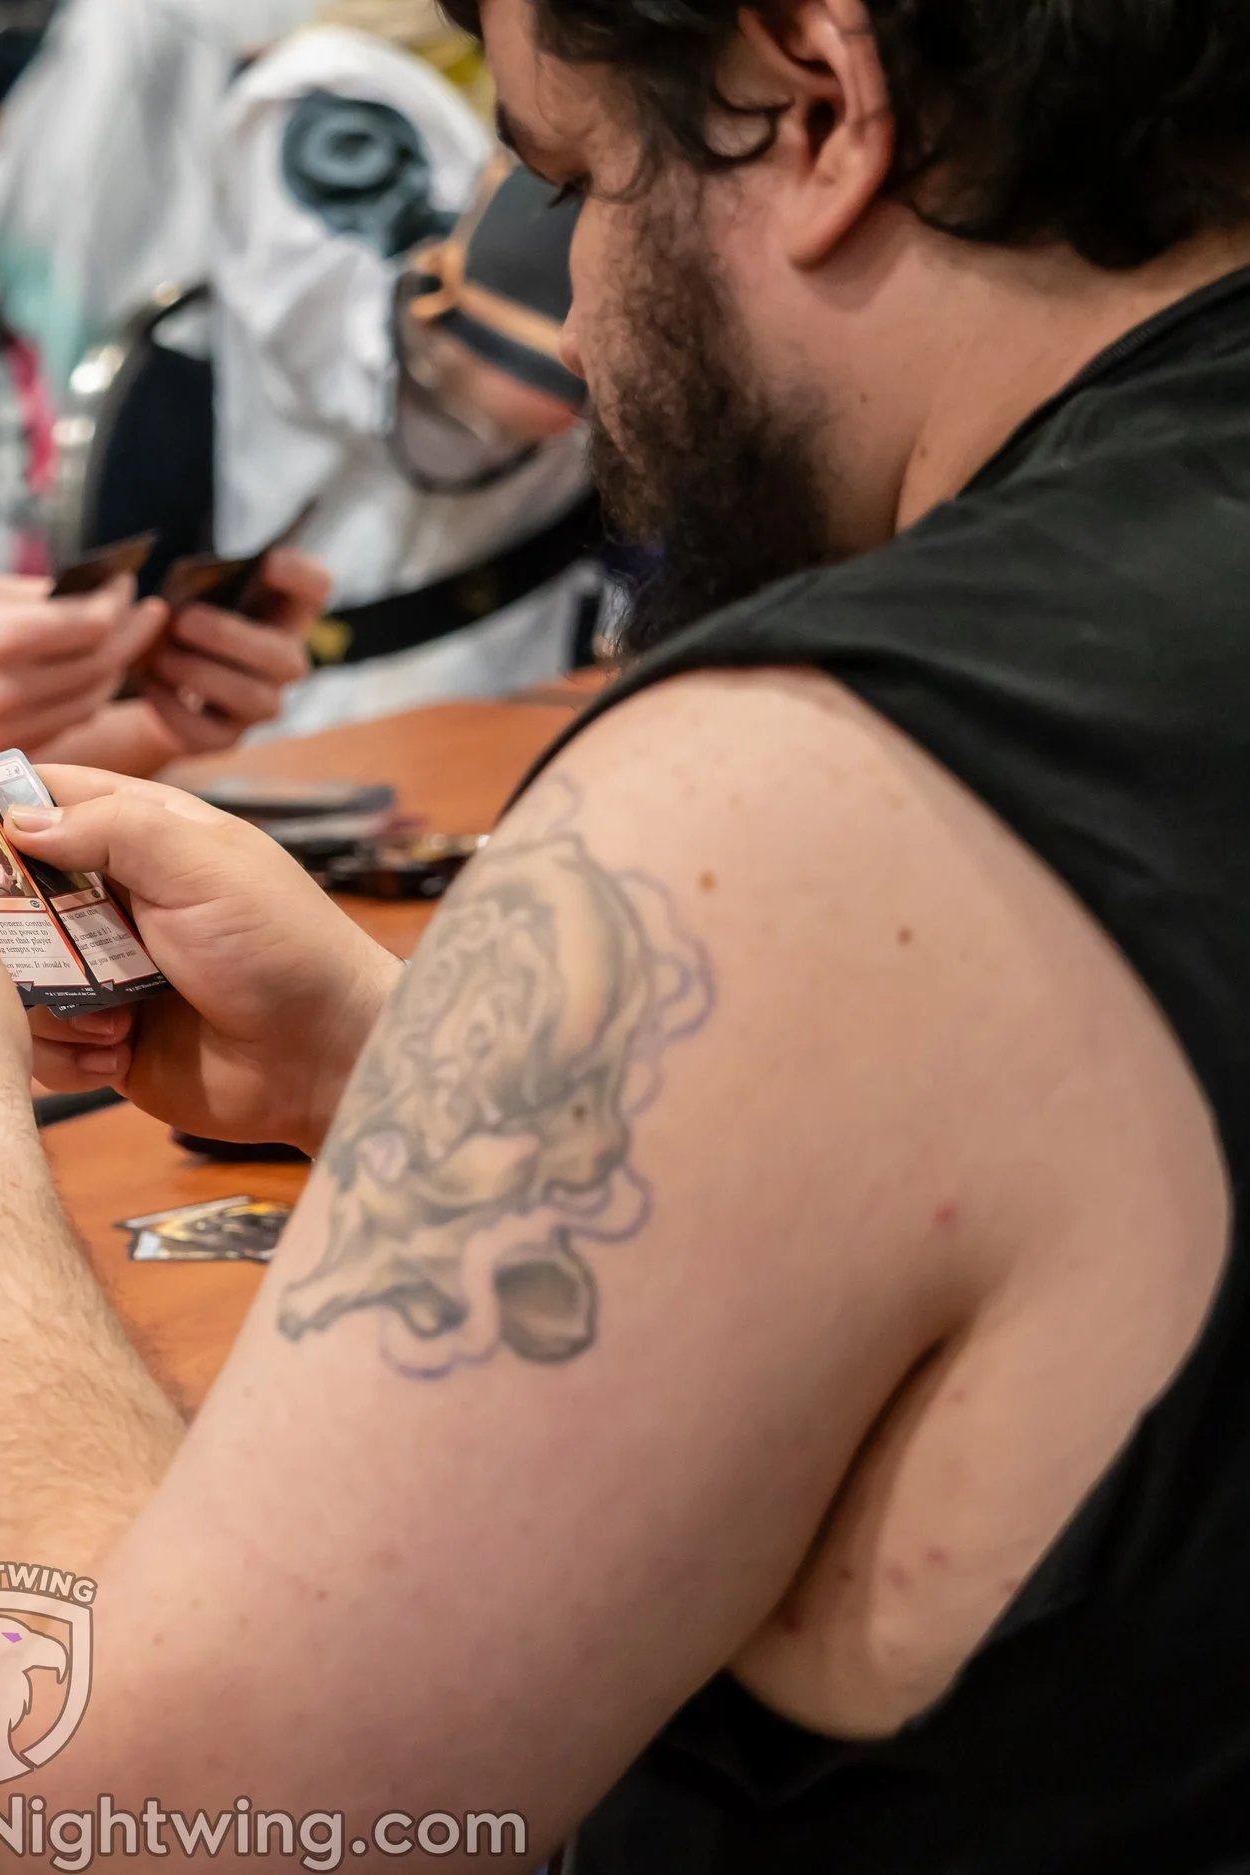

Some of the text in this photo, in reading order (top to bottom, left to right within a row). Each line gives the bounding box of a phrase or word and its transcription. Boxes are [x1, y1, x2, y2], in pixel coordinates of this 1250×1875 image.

[79, 931, 97, 940] create
[100, 926, 112, 935] 1/1
[89, 938, 113, 948] creature
